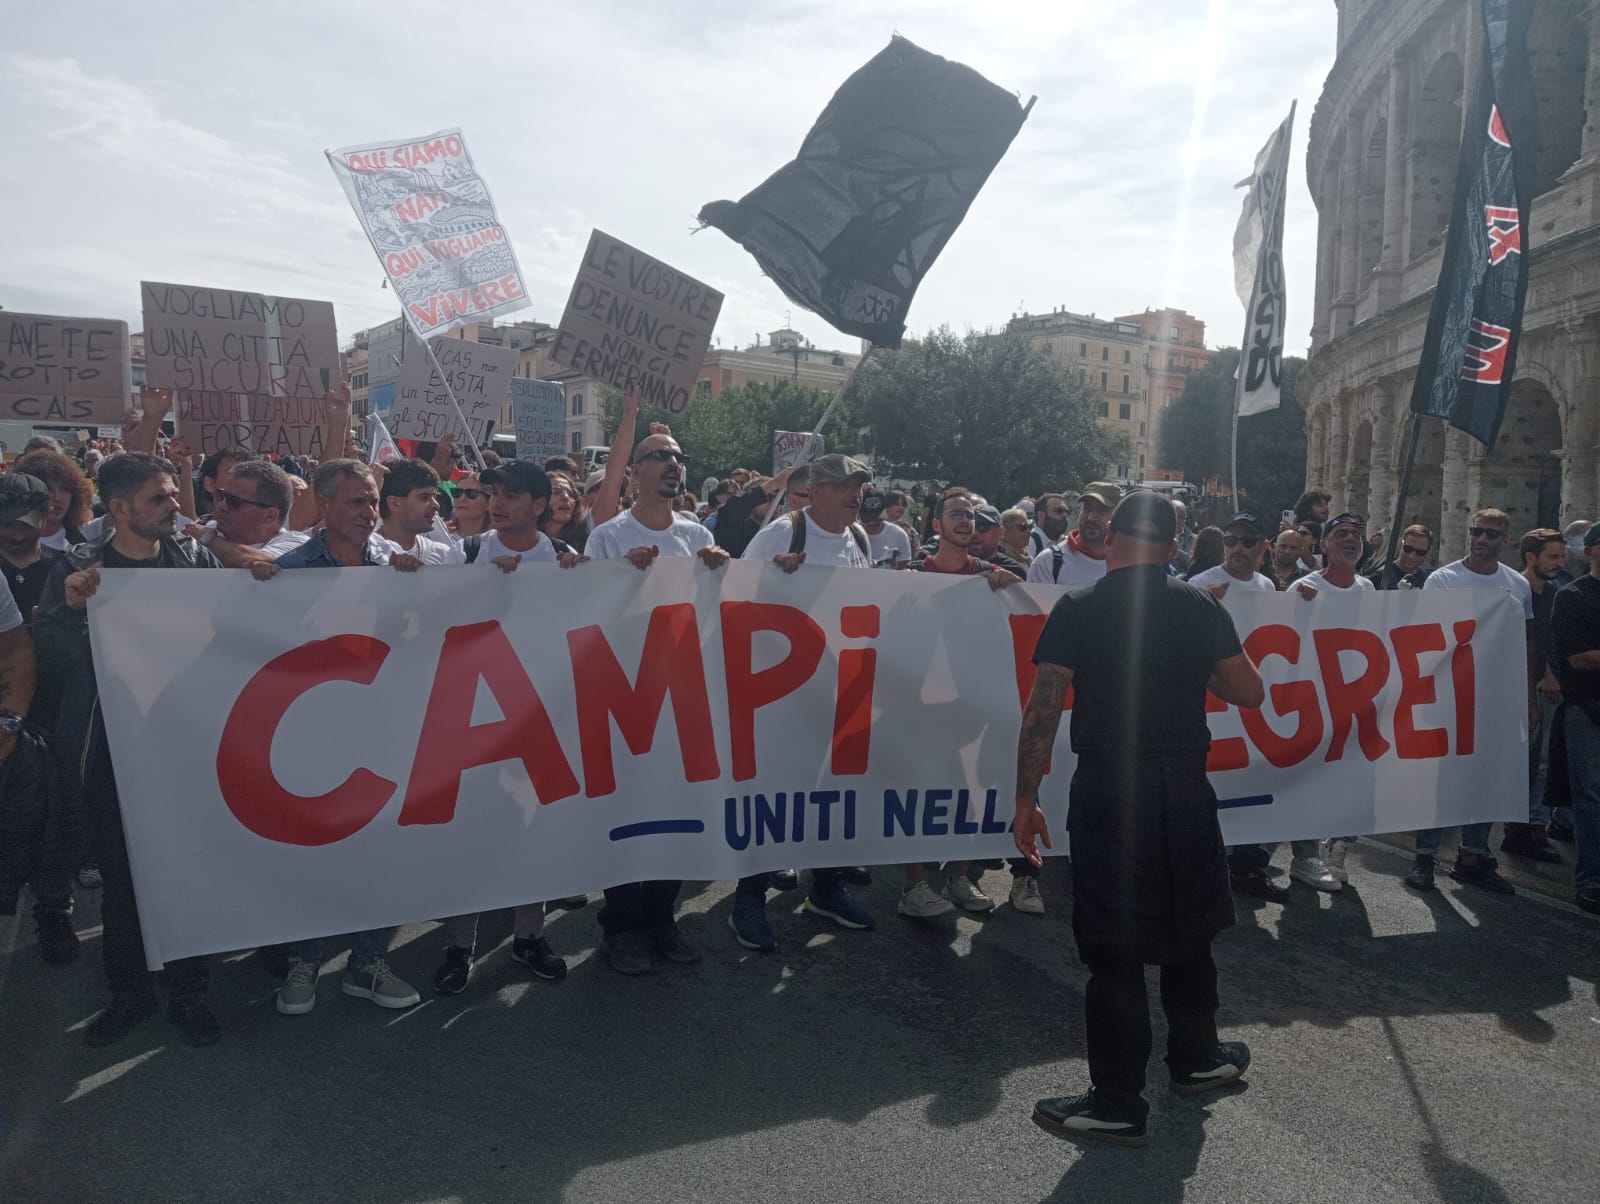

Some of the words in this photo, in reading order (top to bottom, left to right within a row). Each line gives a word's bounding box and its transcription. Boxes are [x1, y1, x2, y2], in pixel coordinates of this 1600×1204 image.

[392, 135, 463, 168] SIAMO
[586, 238, 625, 279] LE
[628, 253, 718, 321] VOSTRE
[147, 286, 305, 328] VOGLIAMO
[572, 280, 697, 361] DENUNCE
[8, 320, 115, 361] AVETE
[150, 327, 205, 358] UNA
[601, 332, 645, 364] NON
[442, 350, 472, 369] CAS
[551, 330, 689, 415] FERMERANNO
[12, 395, 94, 420] CAS
[401, 387, 419, 399] un
[472, 401, 491, 414] per
[201, 424, 325, 454] FORZATA
[724, 789, 856, 850] UNITI
[883, 788, 1017, 837] NELL
